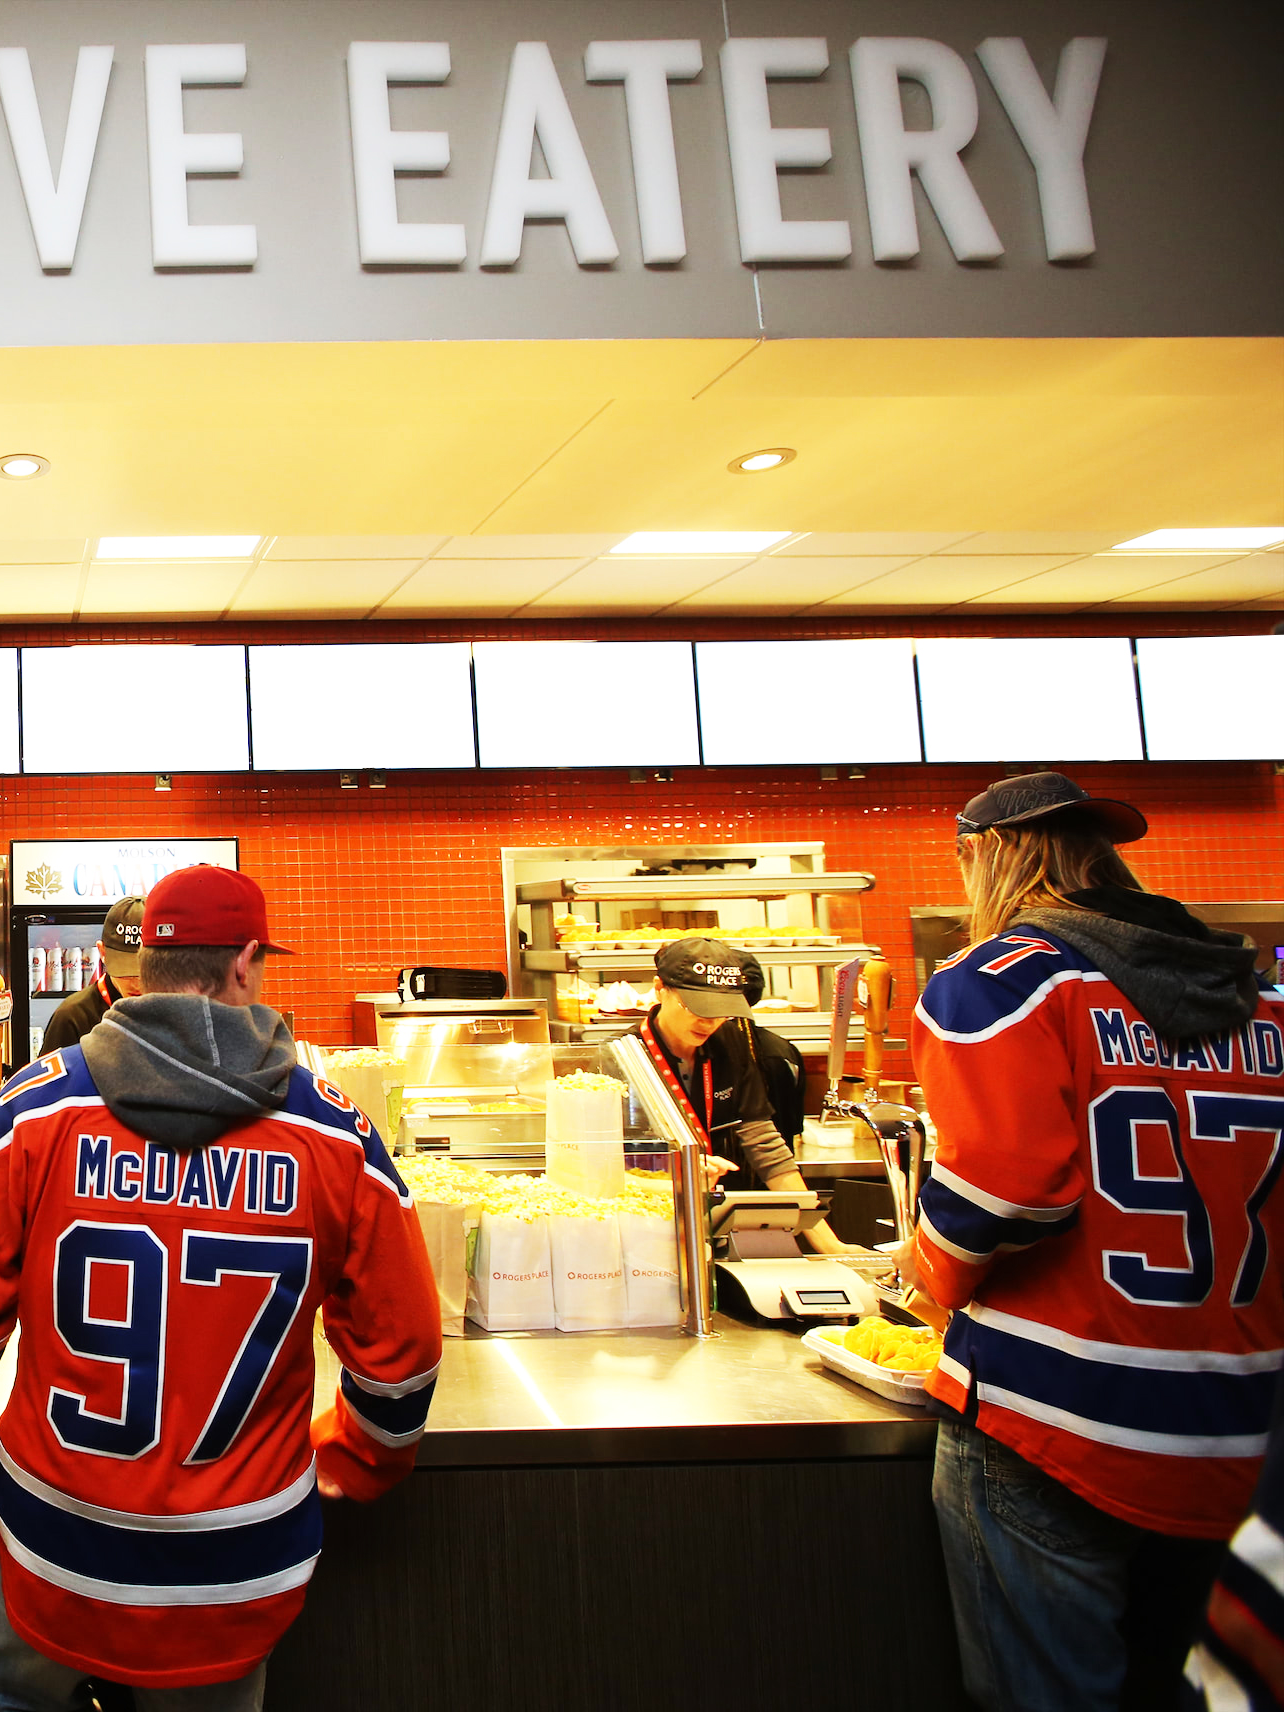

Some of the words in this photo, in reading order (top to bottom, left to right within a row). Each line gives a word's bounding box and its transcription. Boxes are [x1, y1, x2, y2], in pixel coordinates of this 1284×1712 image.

[346, 36, 1109, 268] EATERY
[117, 848, 177, 858] MOLSON
[707, 965, 741, 976] ROGERS
[707, 975, 737, 986] PLACE
[74, 1133, 300, 1216] McDAVID
[1088, 1085, 1284, 1309] 97
[502, 1273, 532, 1282] ROGERS
[531, 1270, 549, 1279] PLACE
[576, 1272, 607, 1280] ROGERS
[47, 1219, 314, 1466] 97
